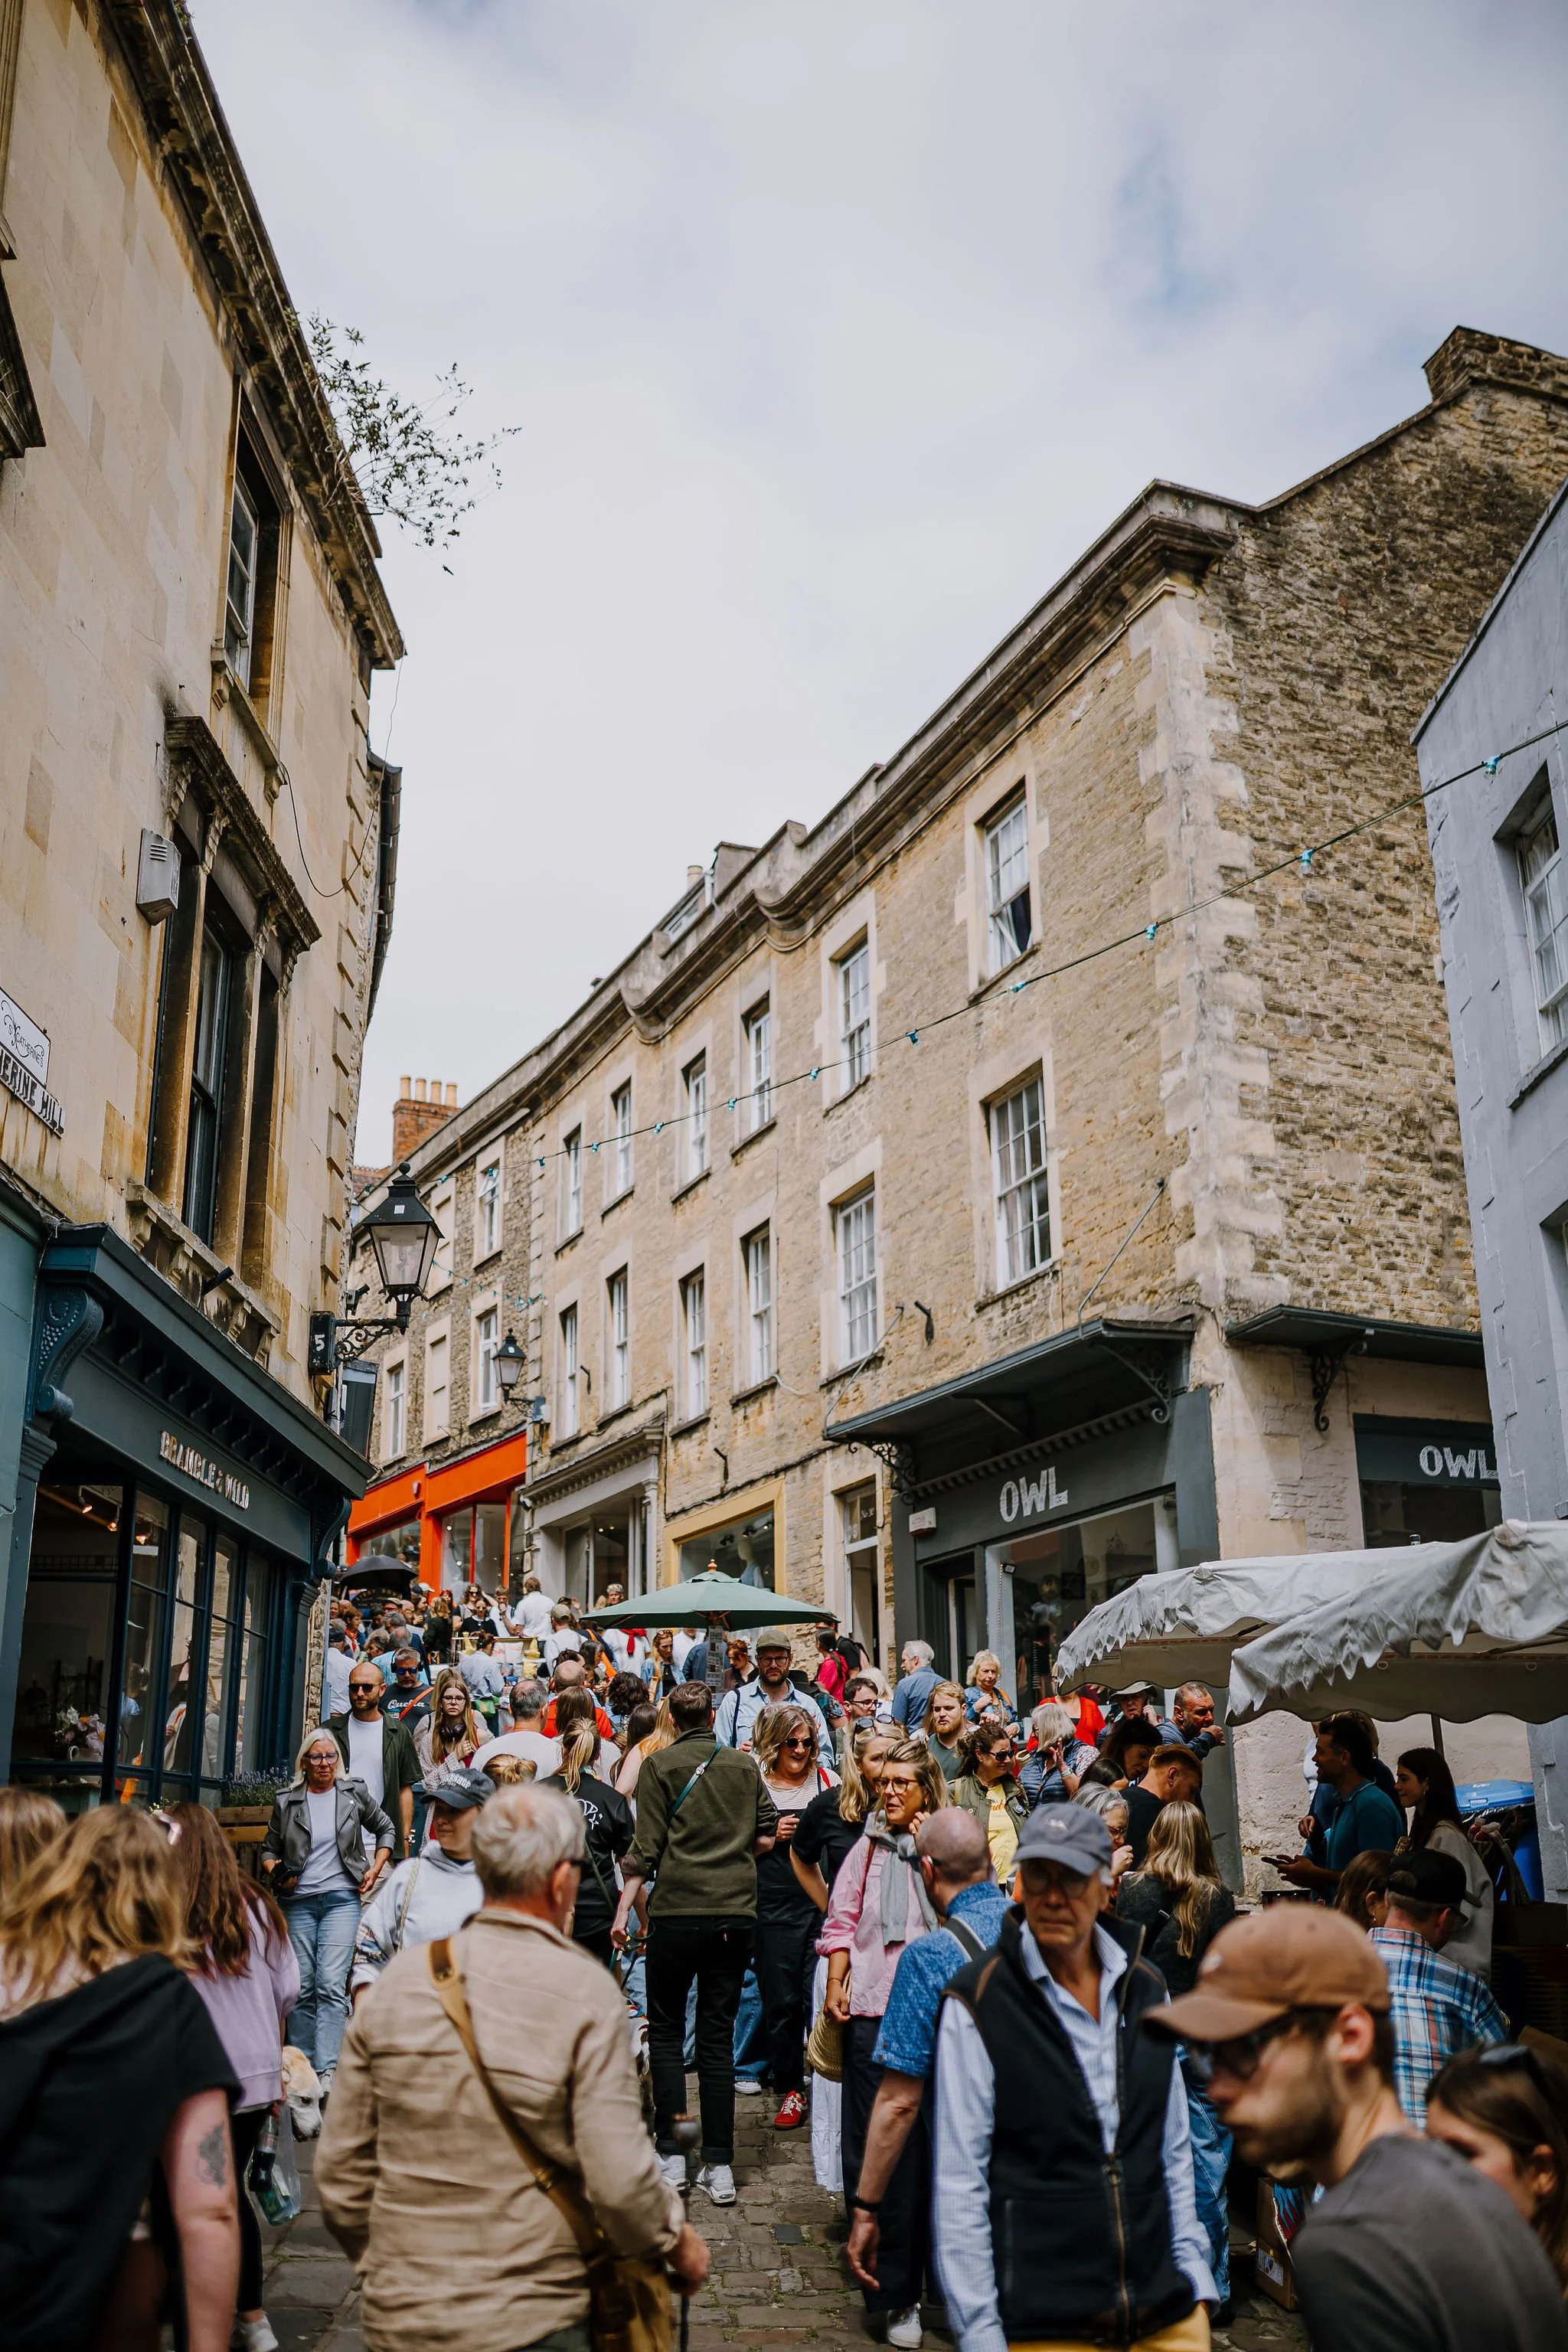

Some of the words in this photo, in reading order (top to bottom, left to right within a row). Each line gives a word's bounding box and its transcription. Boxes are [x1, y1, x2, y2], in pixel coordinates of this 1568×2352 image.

[39, 1091, 64, 1135] HILL
[314, 1334, 325, 1351] 5
[159, 1430, 217, 1489] BRAMBLE
[224, 1474, 250, 1510] WILD
[1419, 1445, 1498, 1480] OWL
[999, 1466, 1069, 1524] OWL
